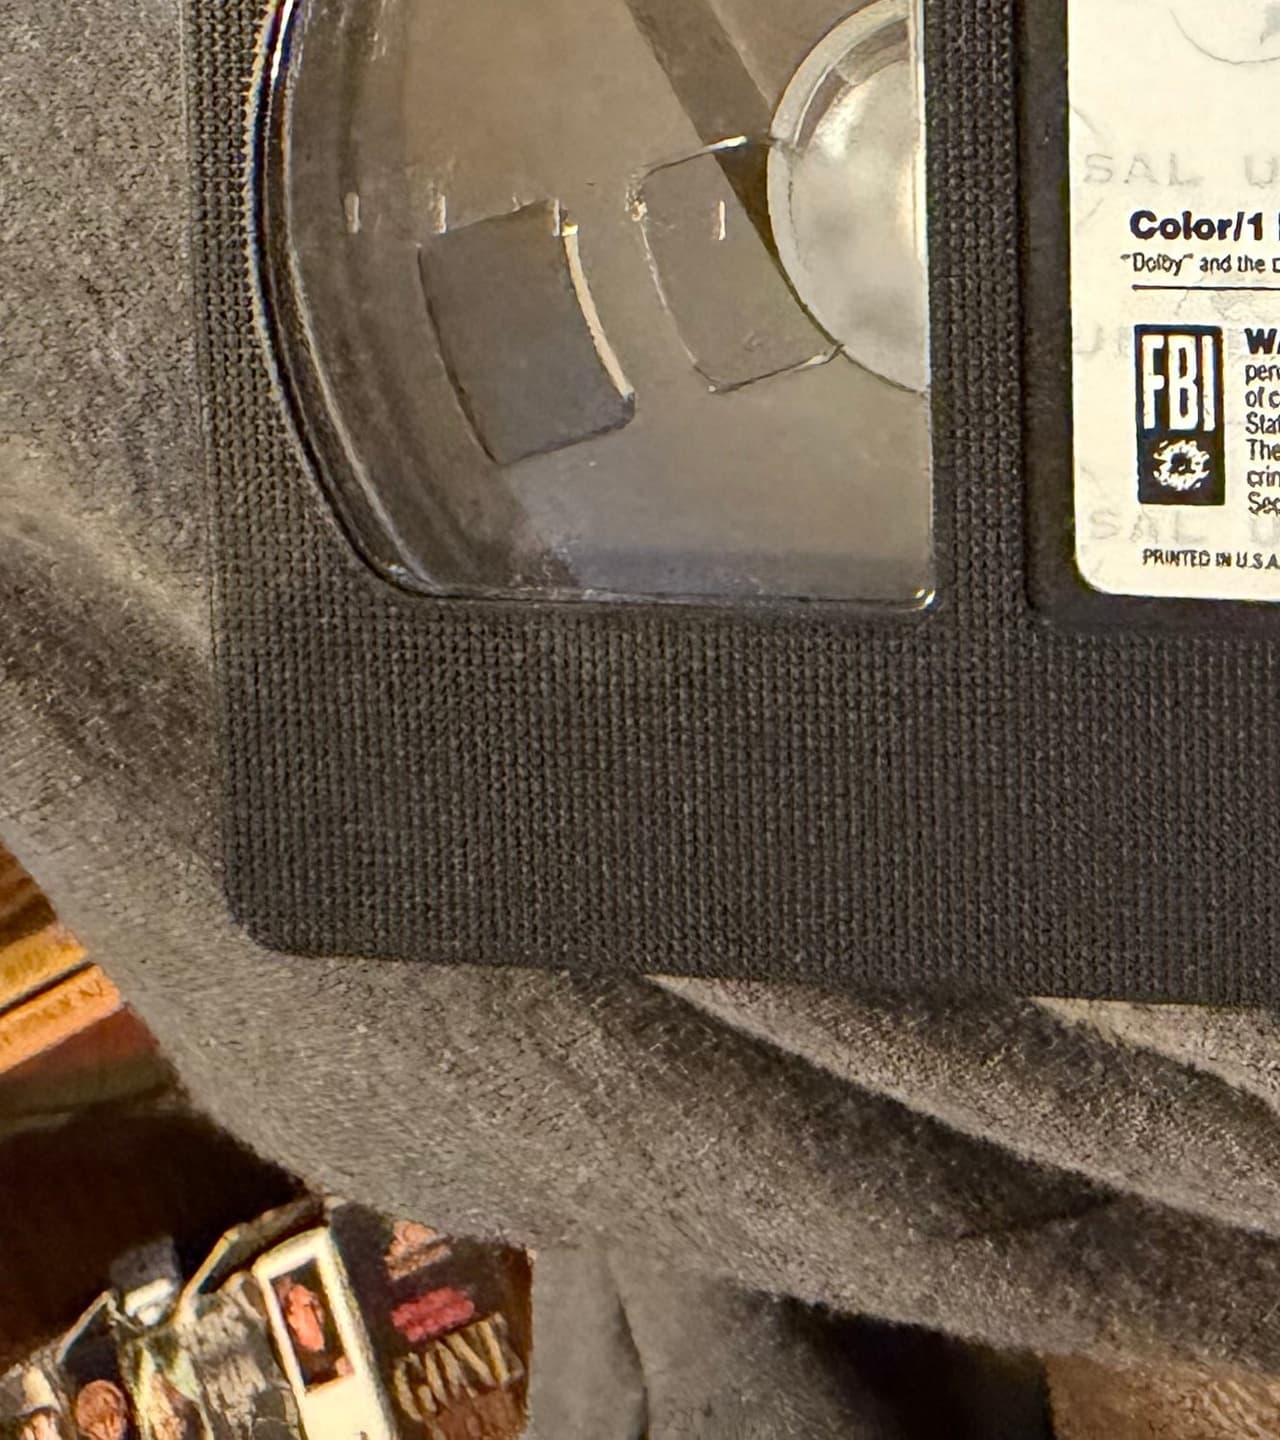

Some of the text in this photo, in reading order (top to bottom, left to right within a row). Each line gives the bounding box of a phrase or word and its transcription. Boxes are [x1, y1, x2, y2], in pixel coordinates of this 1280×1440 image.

[1199, 254, 1232, 274] and
[1237, 254, 1266, 273] the
[1140, 334, 1217, 432] FBI
[1244, 388, 1265, 409] of
[1142, 548, 1211, 567] PRINTED
[1215, 551, 1232, 568] IN
